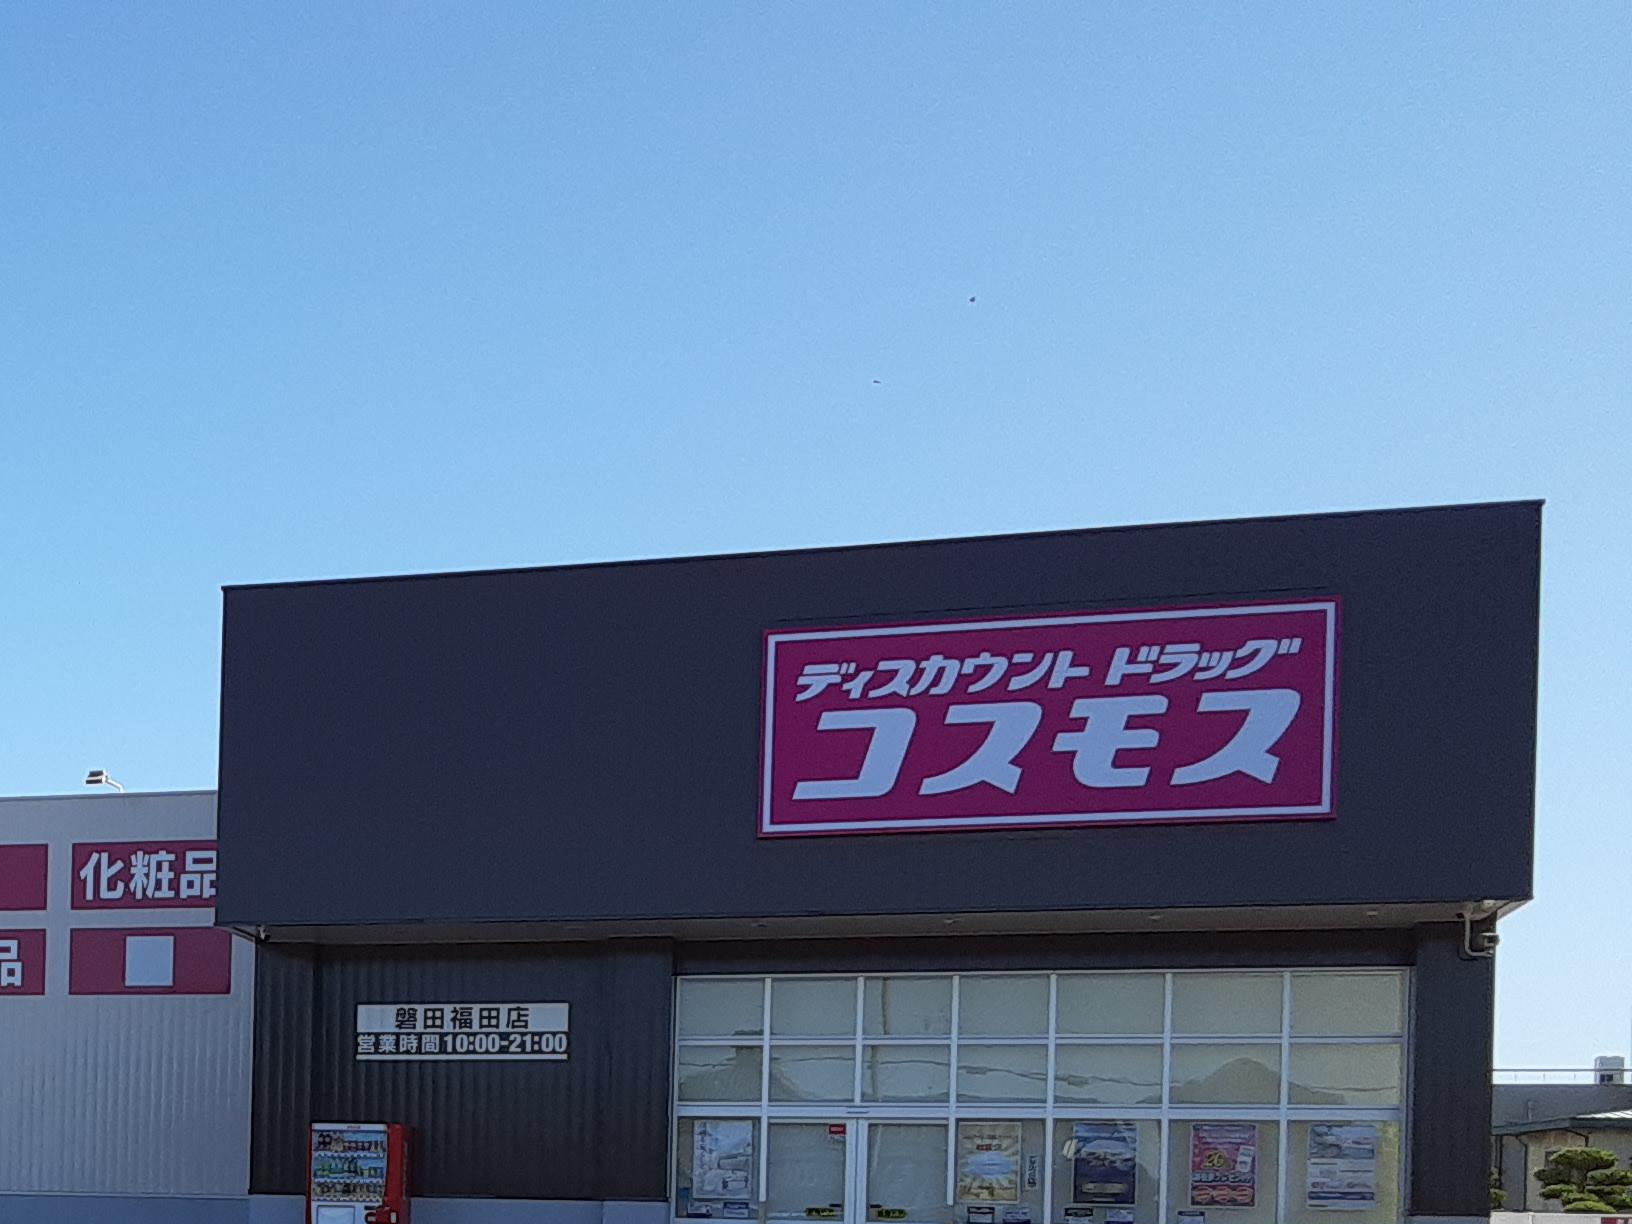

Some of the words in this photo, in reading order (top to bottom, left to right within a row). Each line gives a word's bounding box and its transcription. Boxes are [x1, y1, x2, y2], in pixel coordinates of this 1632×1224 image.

[795, 650, 1090, 701] ディスカウント
[1105, 637, 1302, 687] ドラッグ
[791, 688, 1301, 800] コスモス
[79, 850, 218, 900] 化粧品
[394, 1006, 530, 1030] 磐田福田店
